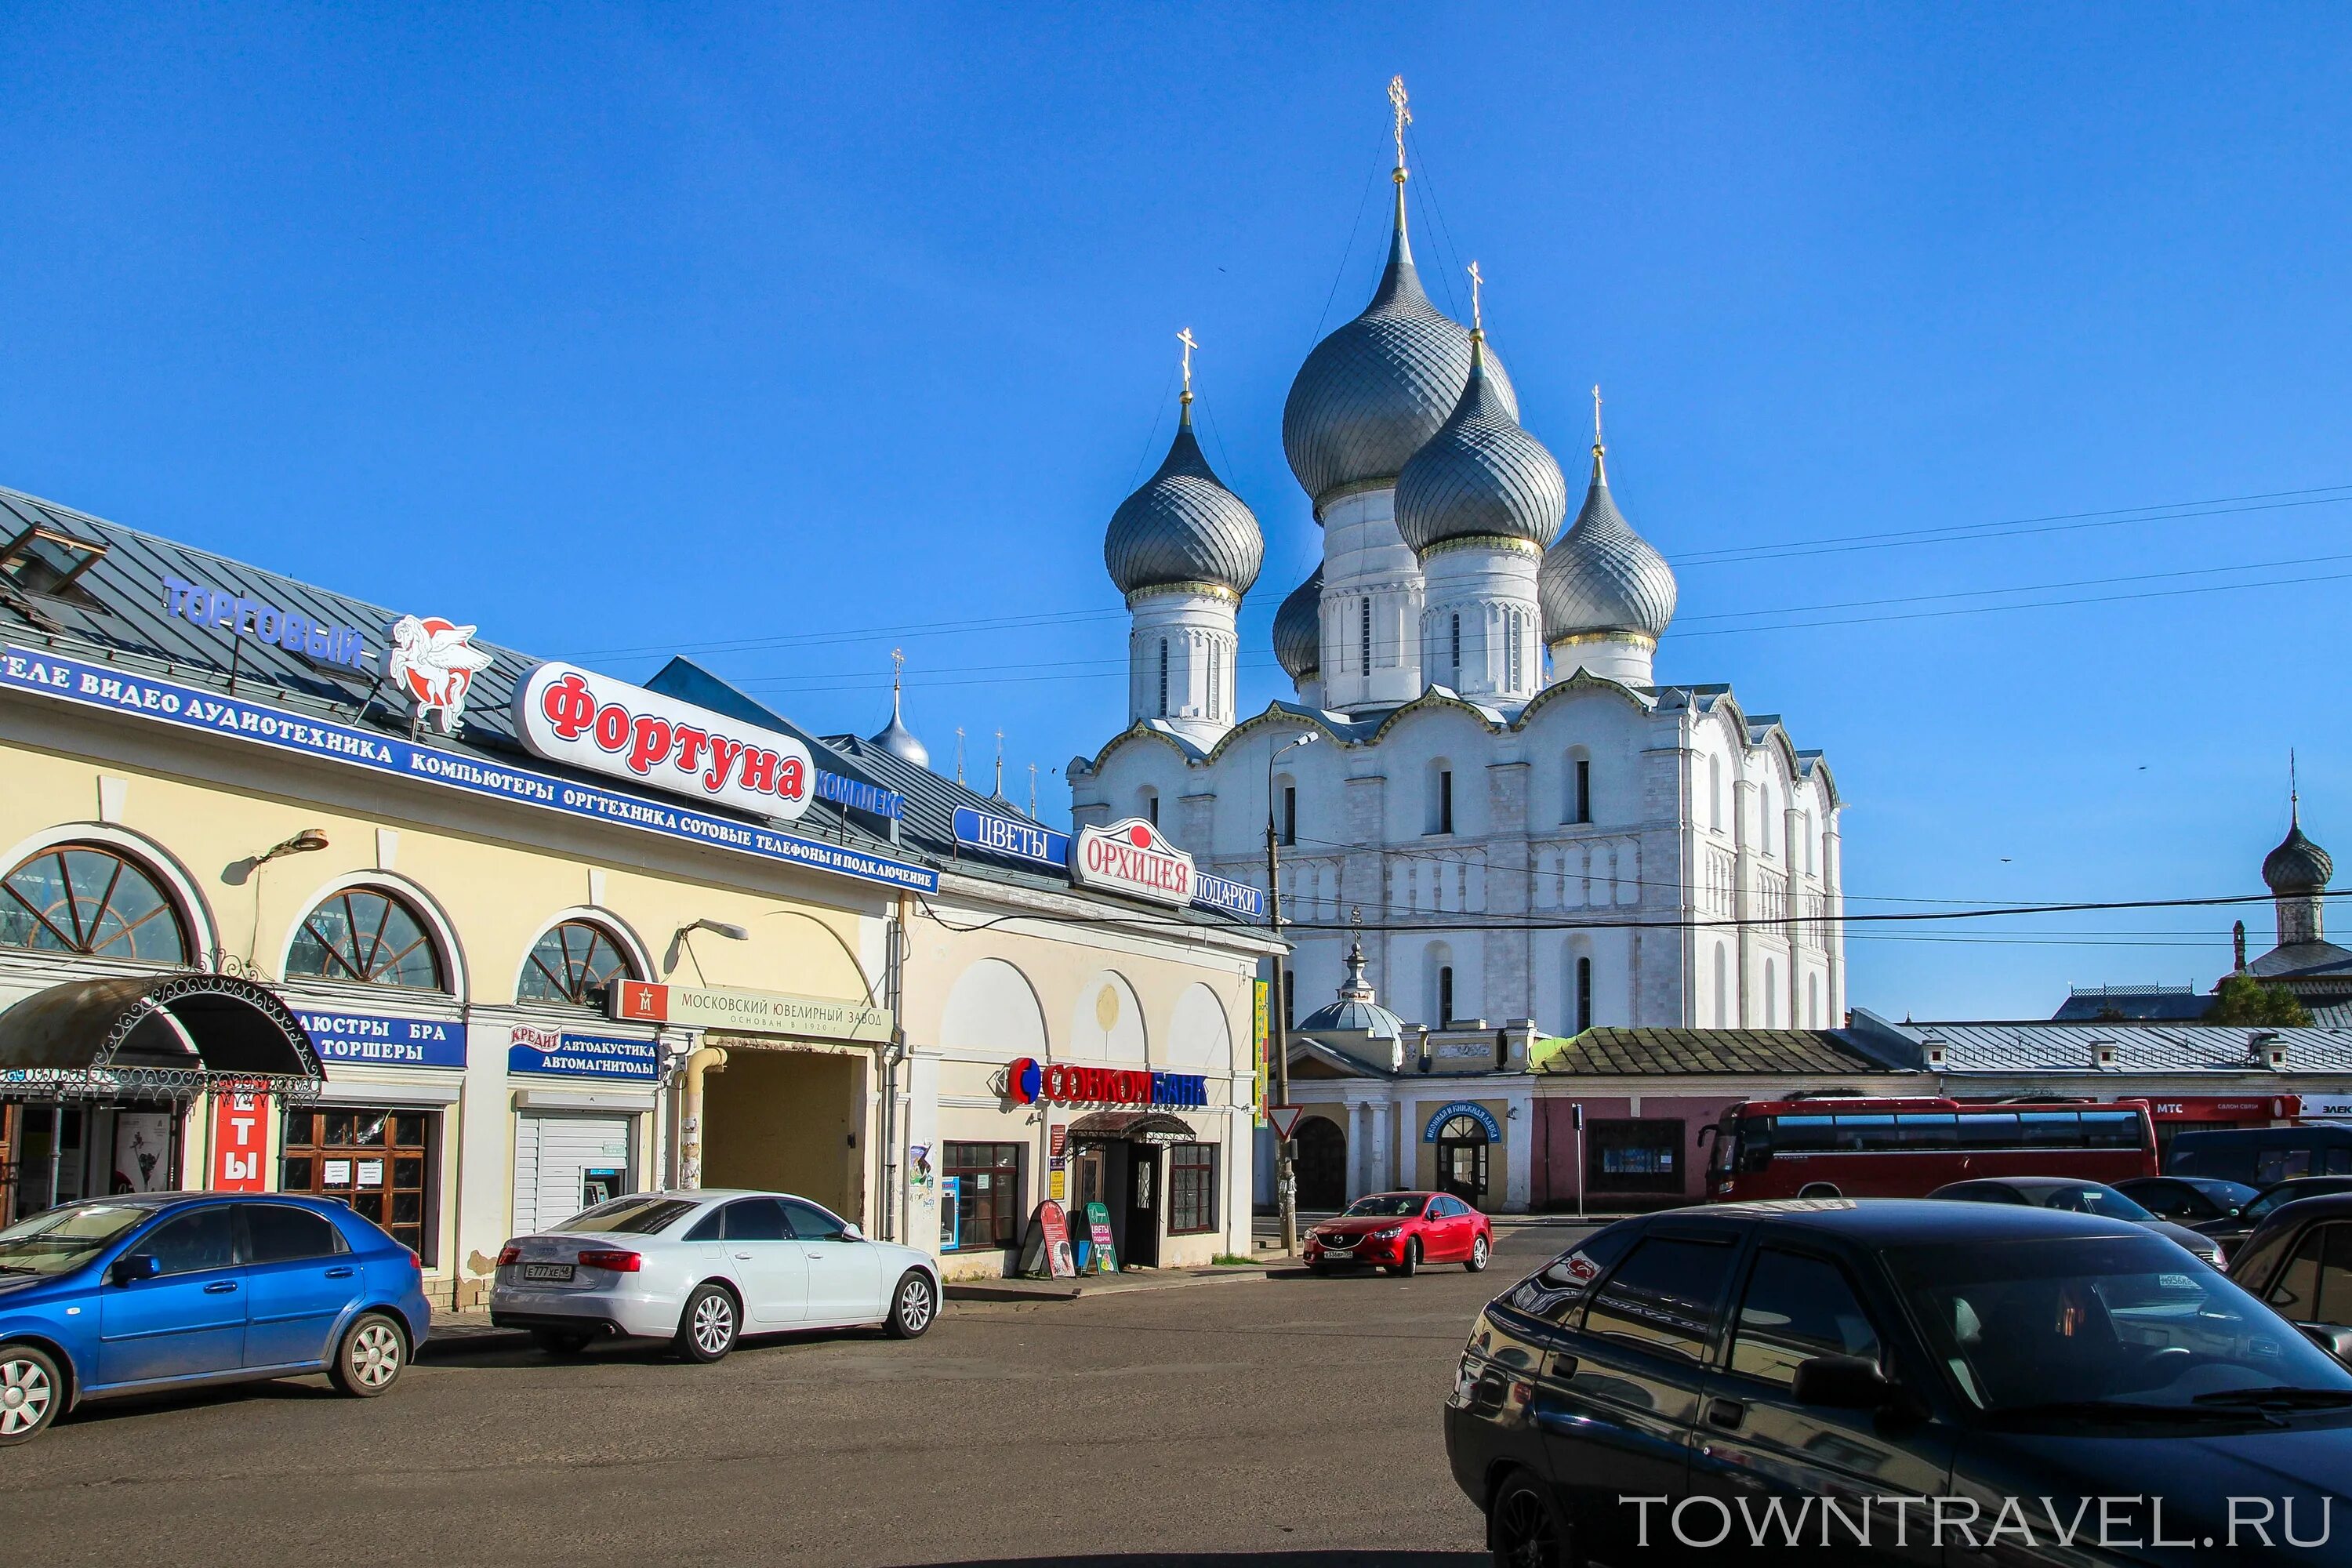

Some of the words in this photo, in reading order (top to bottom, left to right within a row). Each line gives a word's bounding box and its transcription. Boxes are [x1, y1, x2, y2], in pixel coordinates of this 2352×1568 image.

[162, 575, 363, 668] ТОРГОВЫЙ
[542, 673, 806, 801] Фортуна
[80, 673, 180, 713] ВИДЕО
[184, 699, 393, 763] АУДИОТЕХНИКА
[412, 753, 555, 801] КОМПЬЮТЕРЫ
[564, 789, 676, 829] ОРГТЕХНИКА
[681, 817, 752, 847] СОТОВЫЕ
[756, 835, 831, 864] ТЕЛЕФОНЫ
[833, 852, 842, 866] И
[844, 855, 931, 888] ПОДКЛЮЧЕНИЕ
[815, 768, 904, 820] КОМПЛЕКС
[978, 815, 1049, 859] ЦВЕТЫ
[1087, 837, 1188, 895] ОРХИДЕЯ
[1195, 875, 1256, 913] ПОДАРКИ
[681, 993, 768, 1015] МОСКОВСКИЙ
[772, 1003, 844, 1022] ЮВЕЛИРНЫЙ
[848, 1011, 883, 1026] ЗАВОД
[730, 1015, 783, 1028] ОСНОВАН
[804, 1023, 828, 1032] 1920
[300, 1015, 390, 1036] ЛЮСТРЫ
[409, 1023, 447, 1040] БРА
[510, 1028, 559, 1048] КРЕДИТ
[321, 1039, 423, 1060] ТОРШЕРЫ
[542, 1056, 654, 1074] АВТОМАГНИТОЛЫ
[562, 1041, 656, 1058] АВТОАКУСТИКА
[1042, 1065, 1208, 1106] СОВКОМБАНК
[2157, 1104, 2183, 1113] МТС
[1091, 1225, 1109, 1235] ЦВЕТЫ
